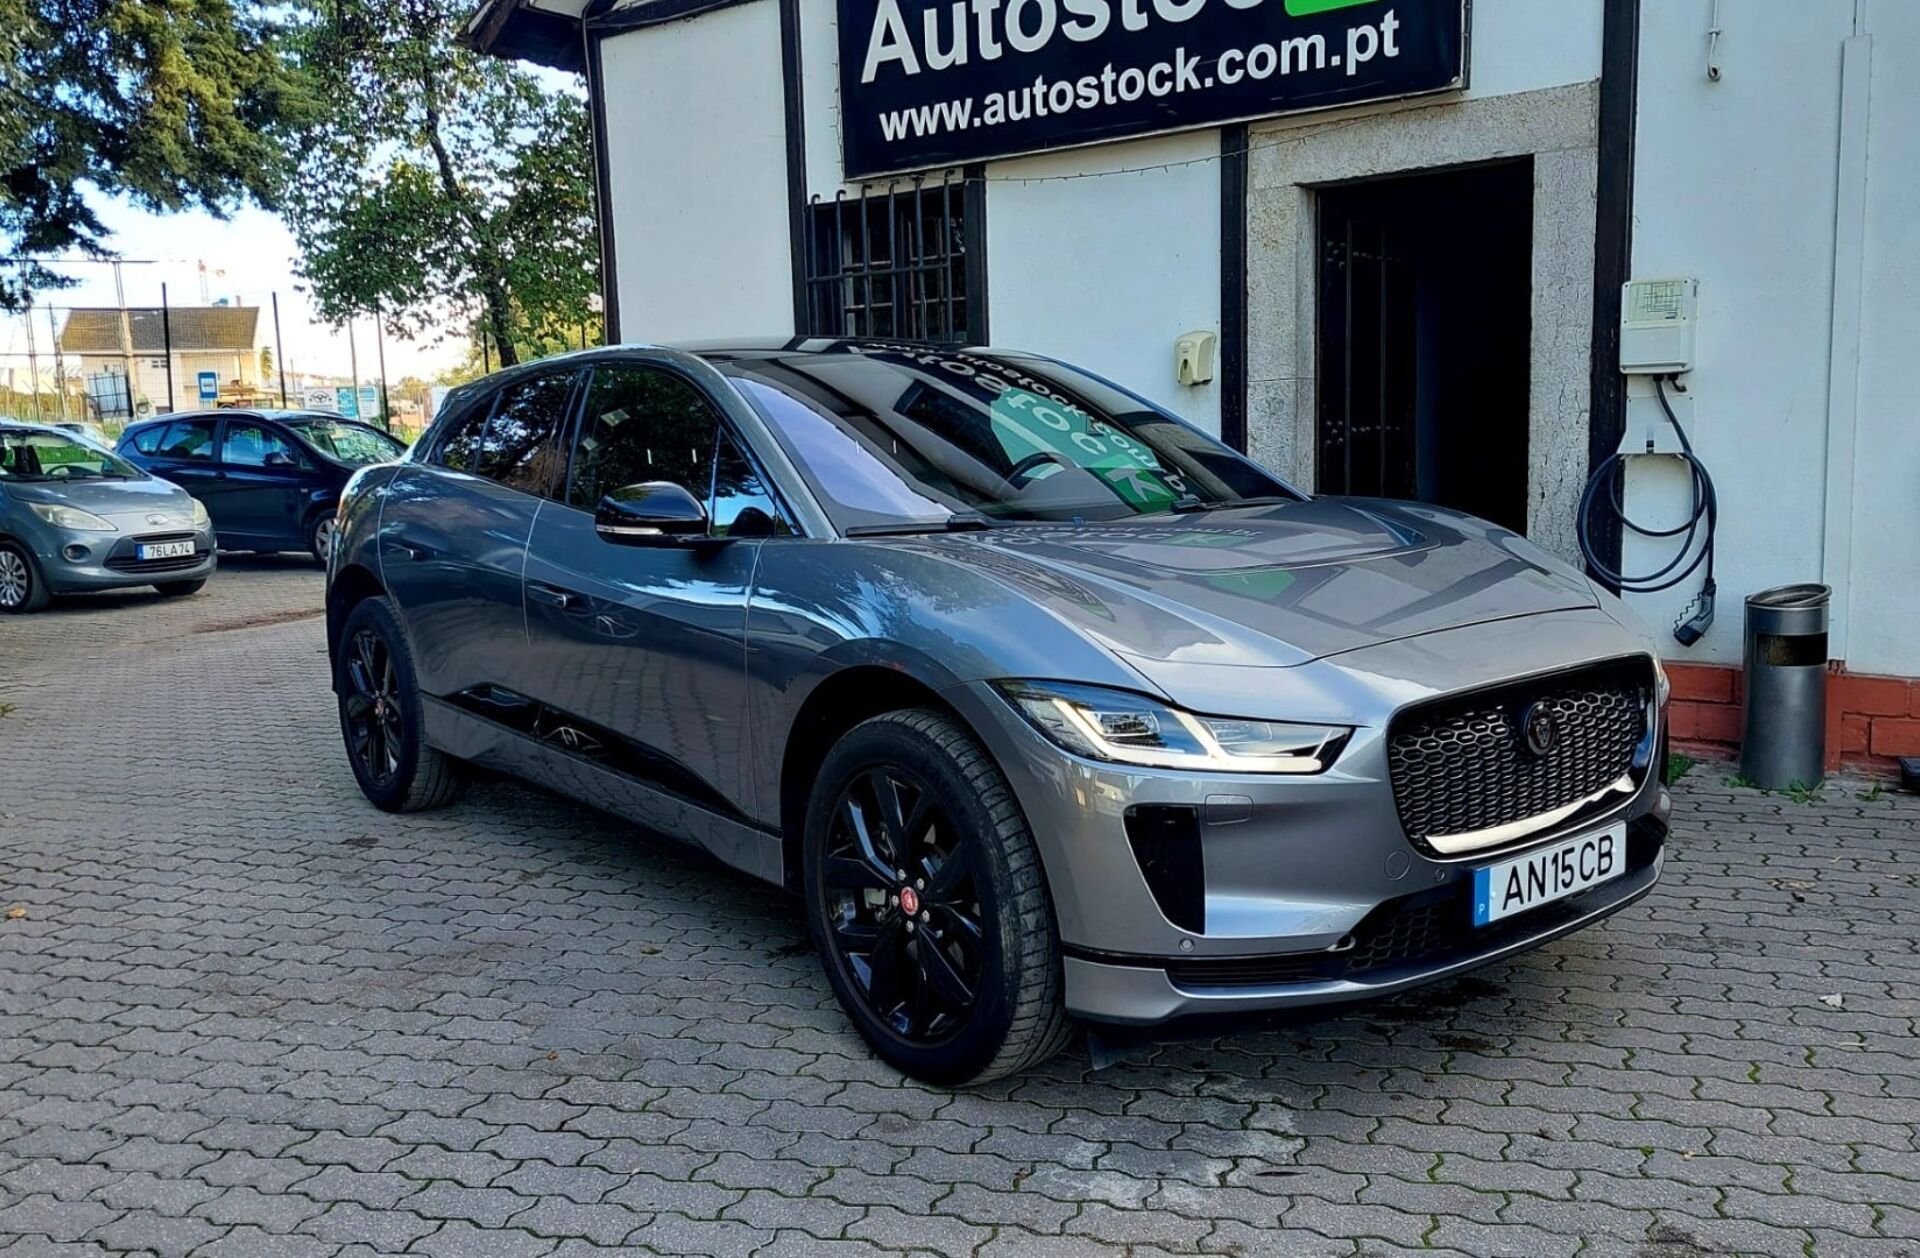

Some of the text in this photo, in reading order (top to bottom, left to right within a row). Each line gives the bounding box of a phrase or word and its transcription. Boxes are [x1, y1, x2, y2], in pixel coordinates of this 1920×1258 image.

[860, 0, 1266, 84] Autos
[879, 10, 1400, 142] www.autostock.com.pt
[1502, 834, 1614, 911] AN15CB
